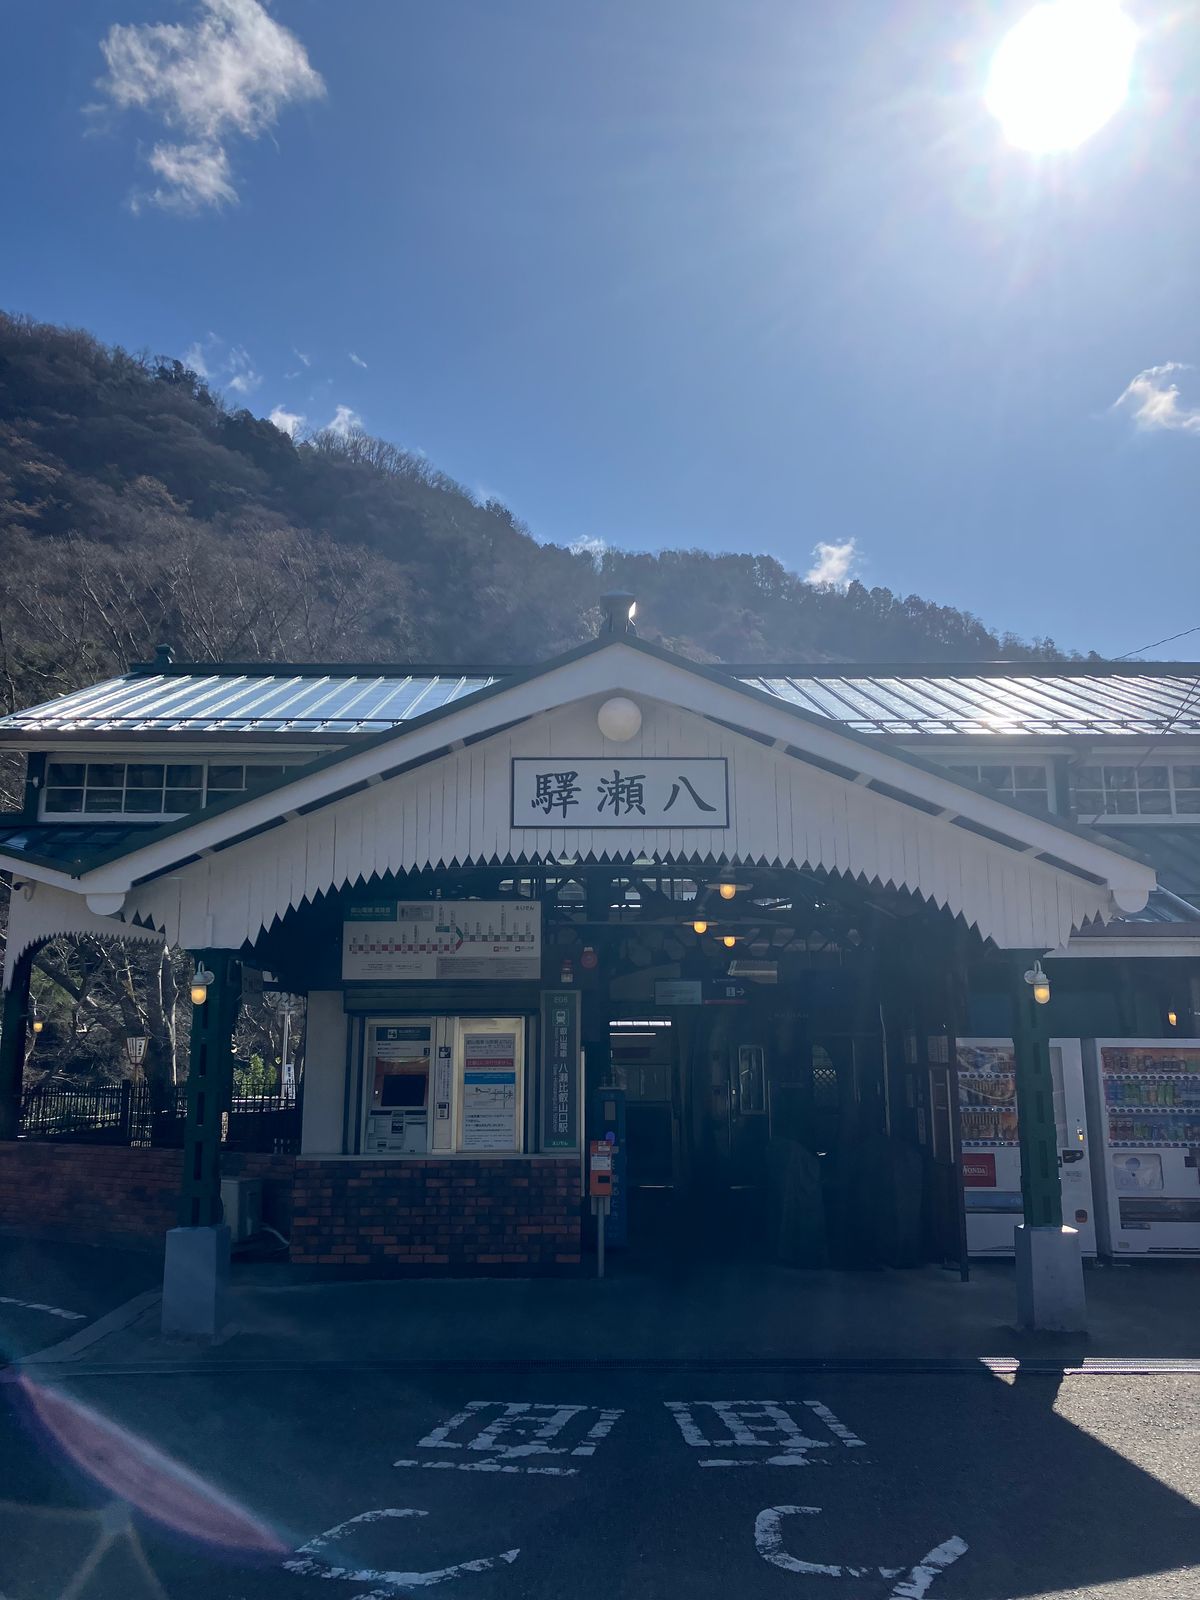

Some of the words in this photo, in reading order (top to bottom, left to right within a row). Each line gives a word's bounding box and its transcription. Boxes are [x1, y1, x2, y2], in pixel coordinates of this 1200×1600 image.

[559, 1063, 568, 1133] 八瀬比叡山口駅
